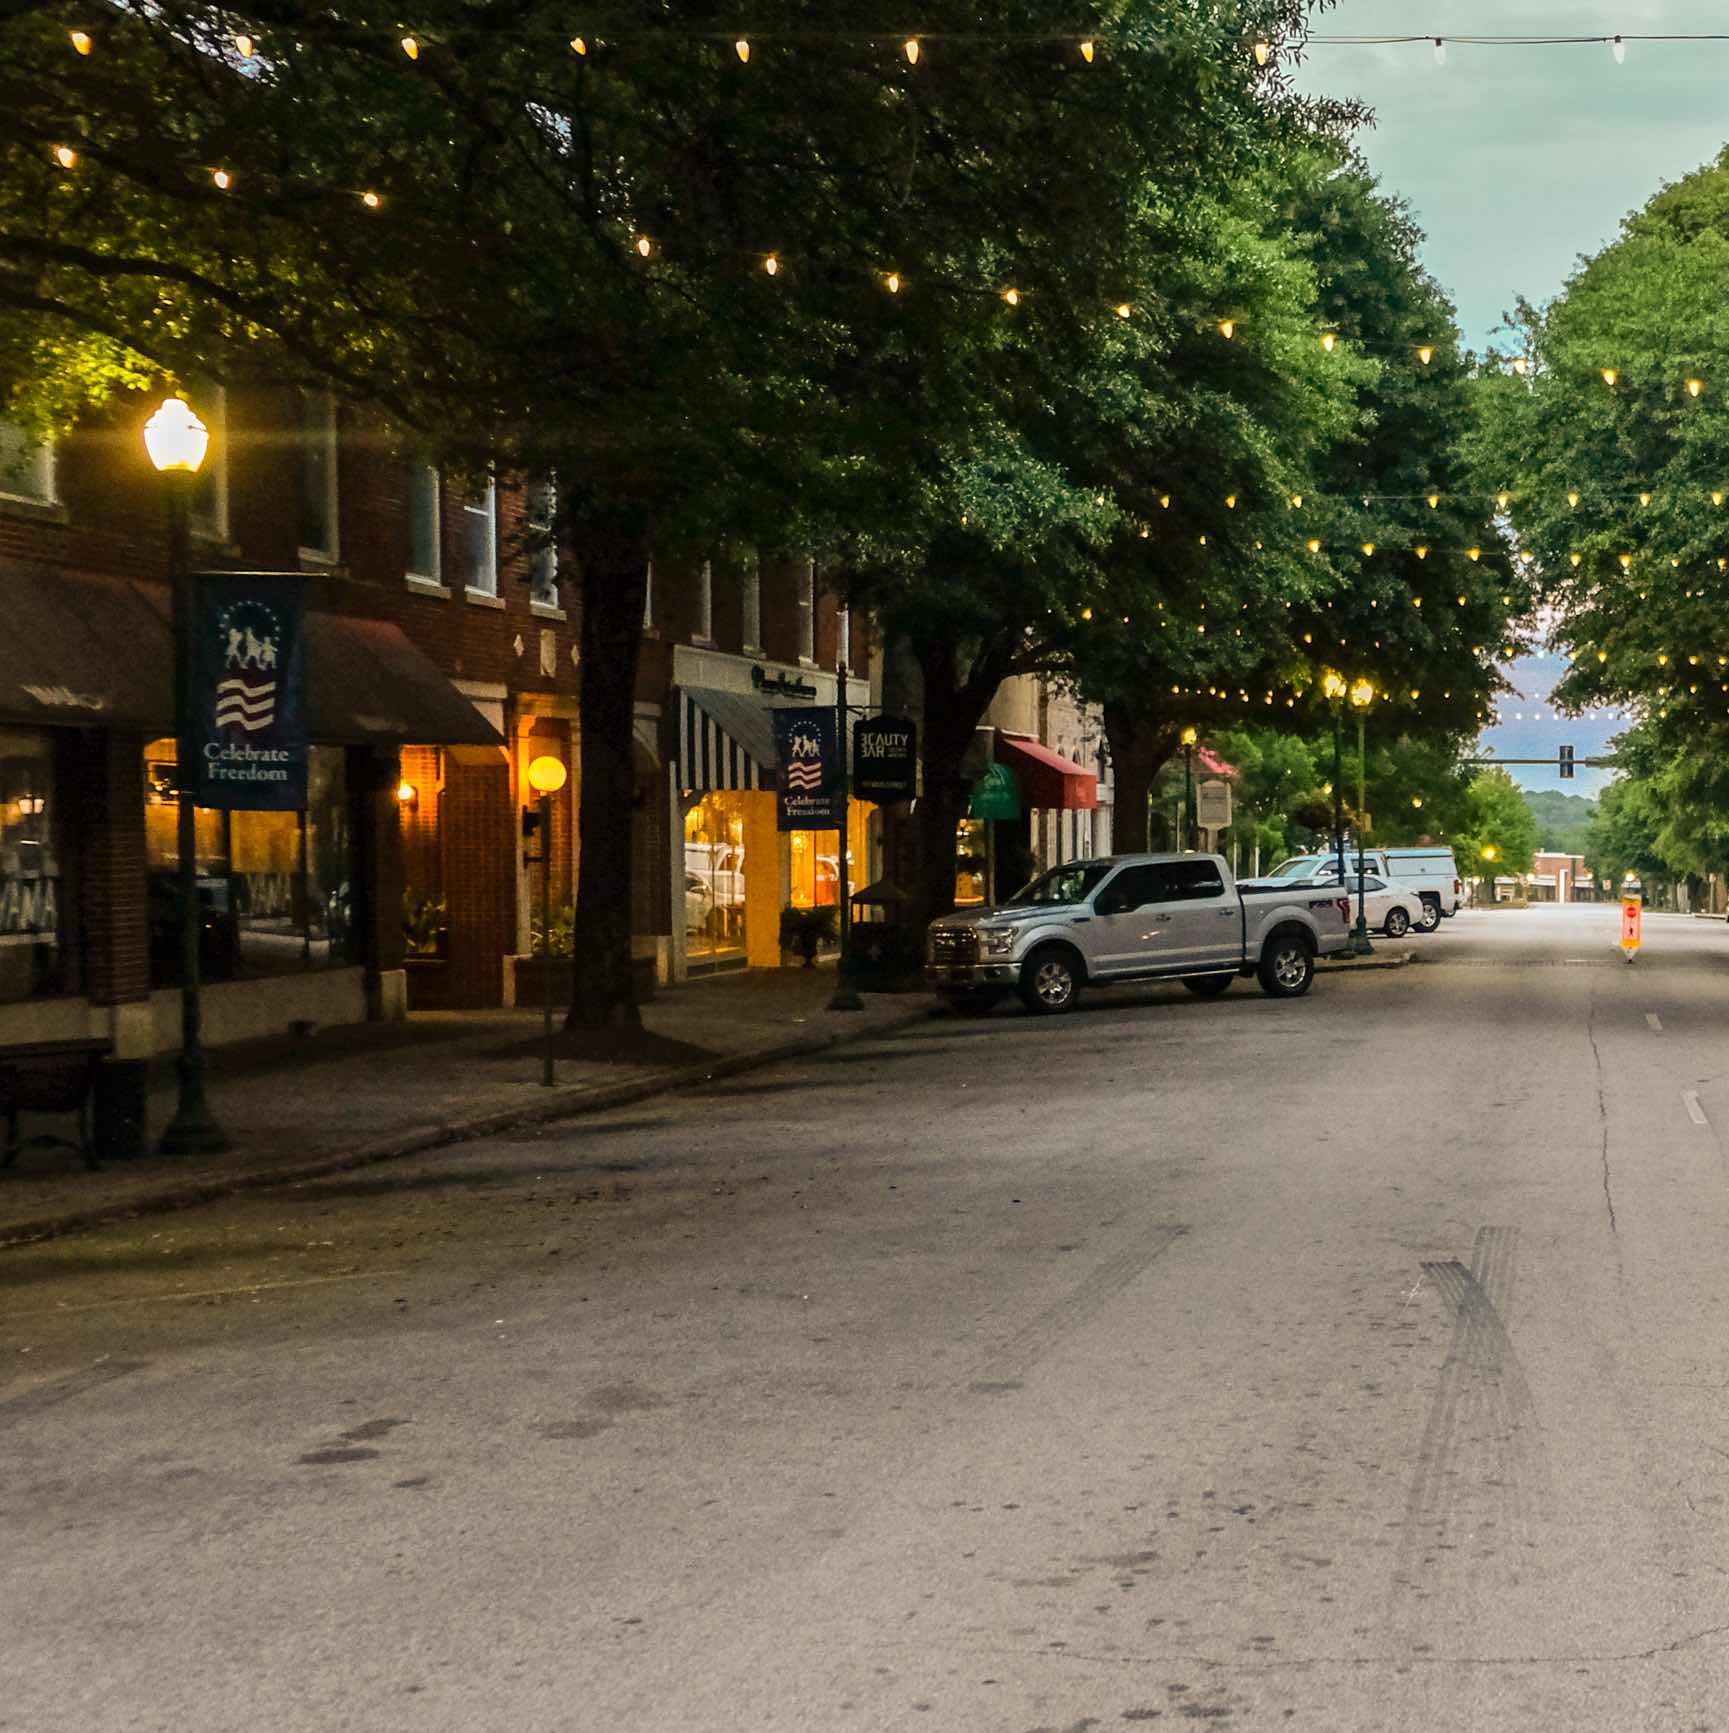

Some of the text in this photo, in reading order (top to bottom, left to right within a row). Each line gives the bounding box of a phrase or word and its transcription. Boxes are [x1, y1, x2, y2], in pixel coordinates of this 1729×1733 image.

[861, 732, 909, 746] BEAUTY
[203, 742, 289, 761] Celebrate
[861, 745, 885, 758] BAR
[207, 761, 289, 781] Freedom
